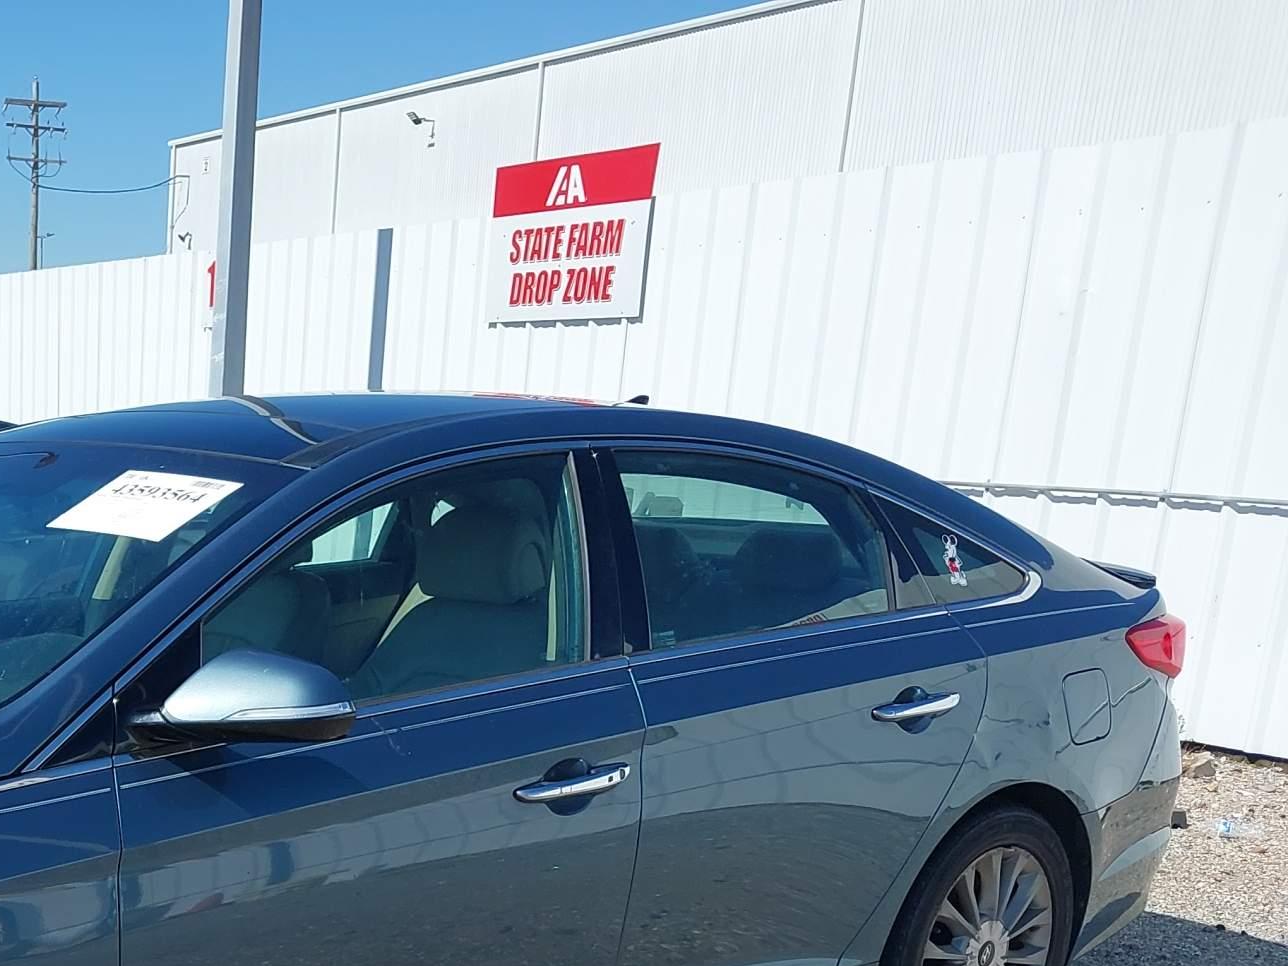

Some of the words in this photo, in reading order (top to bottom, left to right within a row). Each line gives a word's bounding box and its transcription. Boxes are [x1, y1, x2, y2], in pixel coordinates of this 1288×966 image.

[510, 225, 565, 265] STATE
[566, 219, 625, 260] FARM
[509, 269, 562, 307] DROP
[561, 265, 616, 304] ZONE
